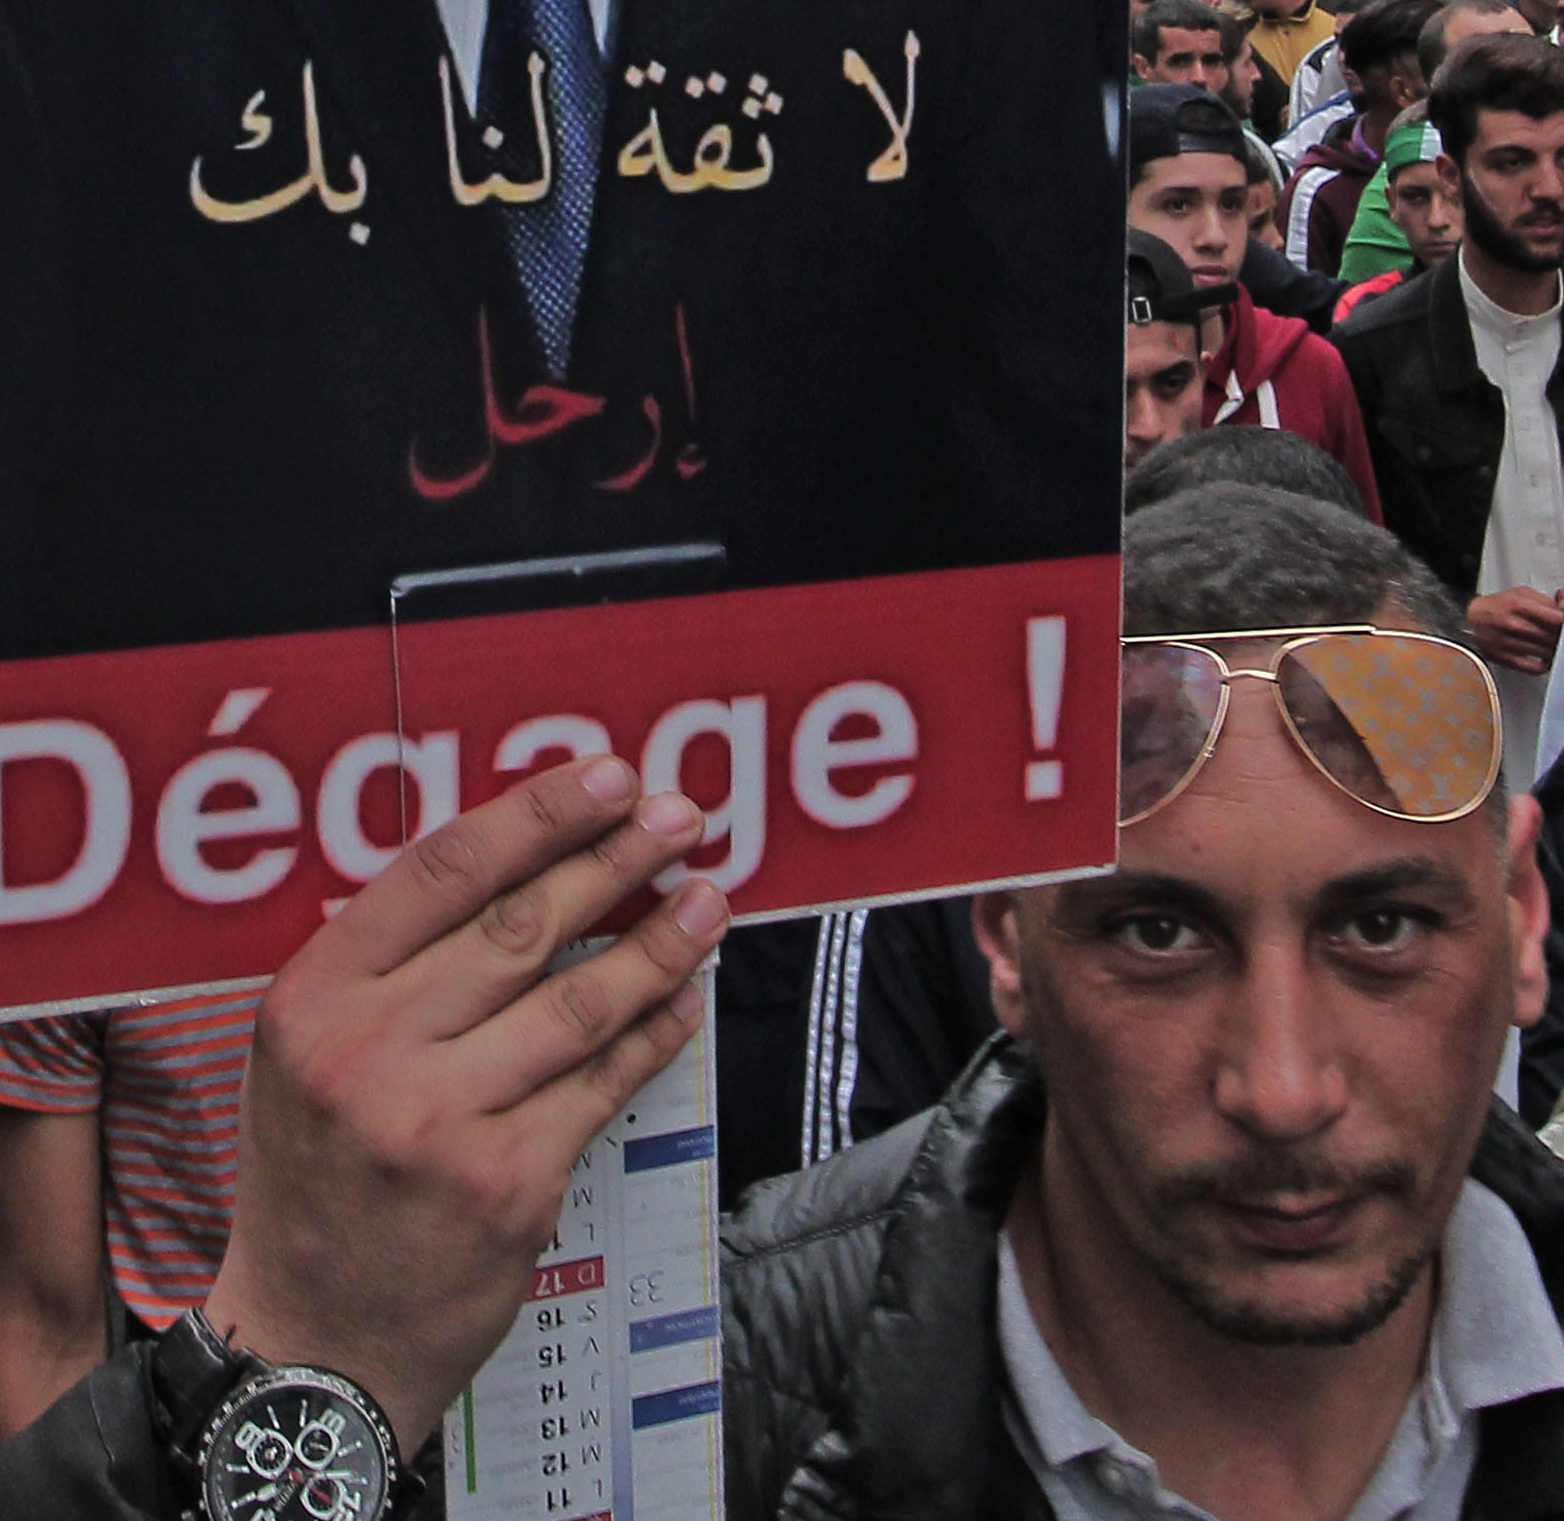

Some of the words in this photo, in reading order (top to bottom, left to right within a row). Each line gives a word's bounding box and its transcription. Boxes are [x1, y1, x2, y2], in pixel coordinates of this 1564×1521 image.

[843, 29, 921, 182] لا
[438, 51, 552, 206] لنا
[618, 60, 784, 194] ثقة
[190, 59, 371, 246] بك
[535, 1270, 566, 1297] 17
[578, 1263, 595, 1285] D
[537, 1308, 566, 1332] 16
[538, 1343, 567, 1368] 15
[539, 1380, 568, 1404] 14
[541, 1416, 570, 1440] 13
[542, 1451, 571, 1476] 12
[546, 1487, 572, 1512] 11
